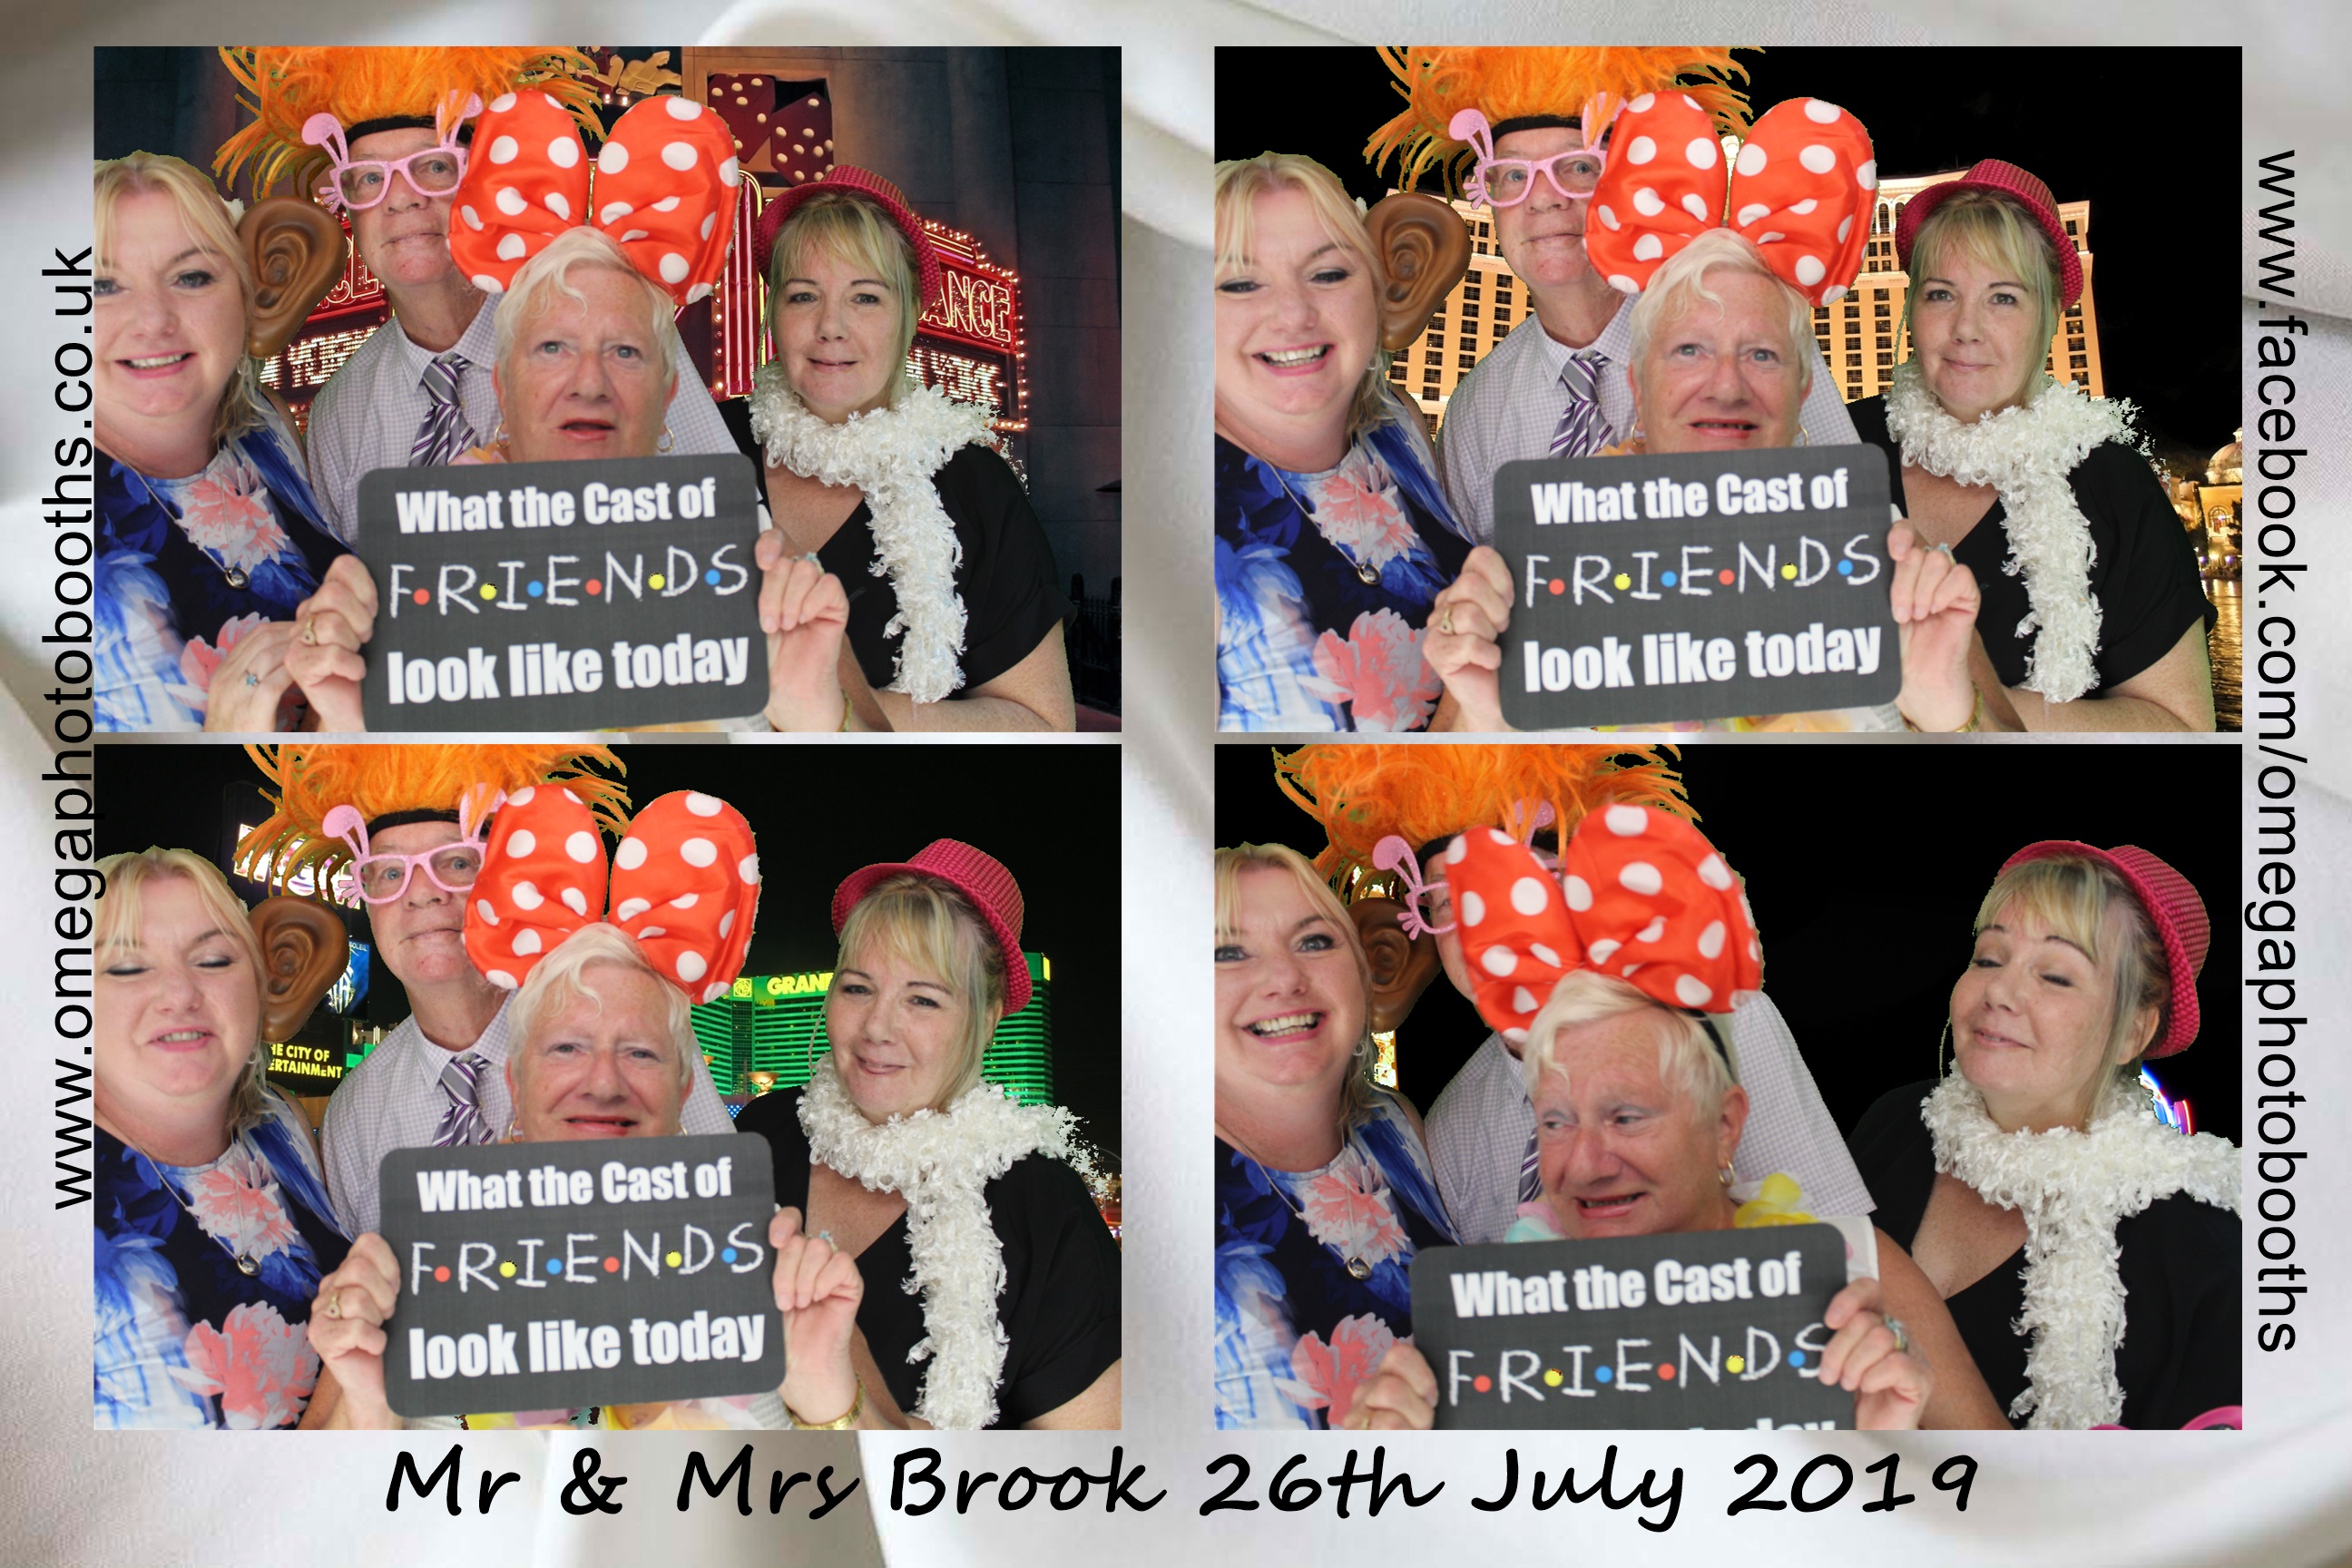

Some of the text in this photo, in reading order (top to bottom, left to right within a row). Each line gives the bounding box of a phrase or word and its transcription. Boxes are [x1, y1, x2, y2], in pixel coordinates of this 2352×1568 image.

[396, 477, 716, 534] What the Cast of
[1531, 468, 1848, 524] What the Cast of
[387, 633, 749, 704] look like today
[1524, 623, 1881, 692] look like today
[286, 1045, 311, 1060] CITY
[314, 1049, 329, 1062] OF
[416, 1157, 732, 1212] What the Cast of
[1450, 1251, 1802, 1318] What the Cast of
[408, 1310, 765, 1380] look like today
